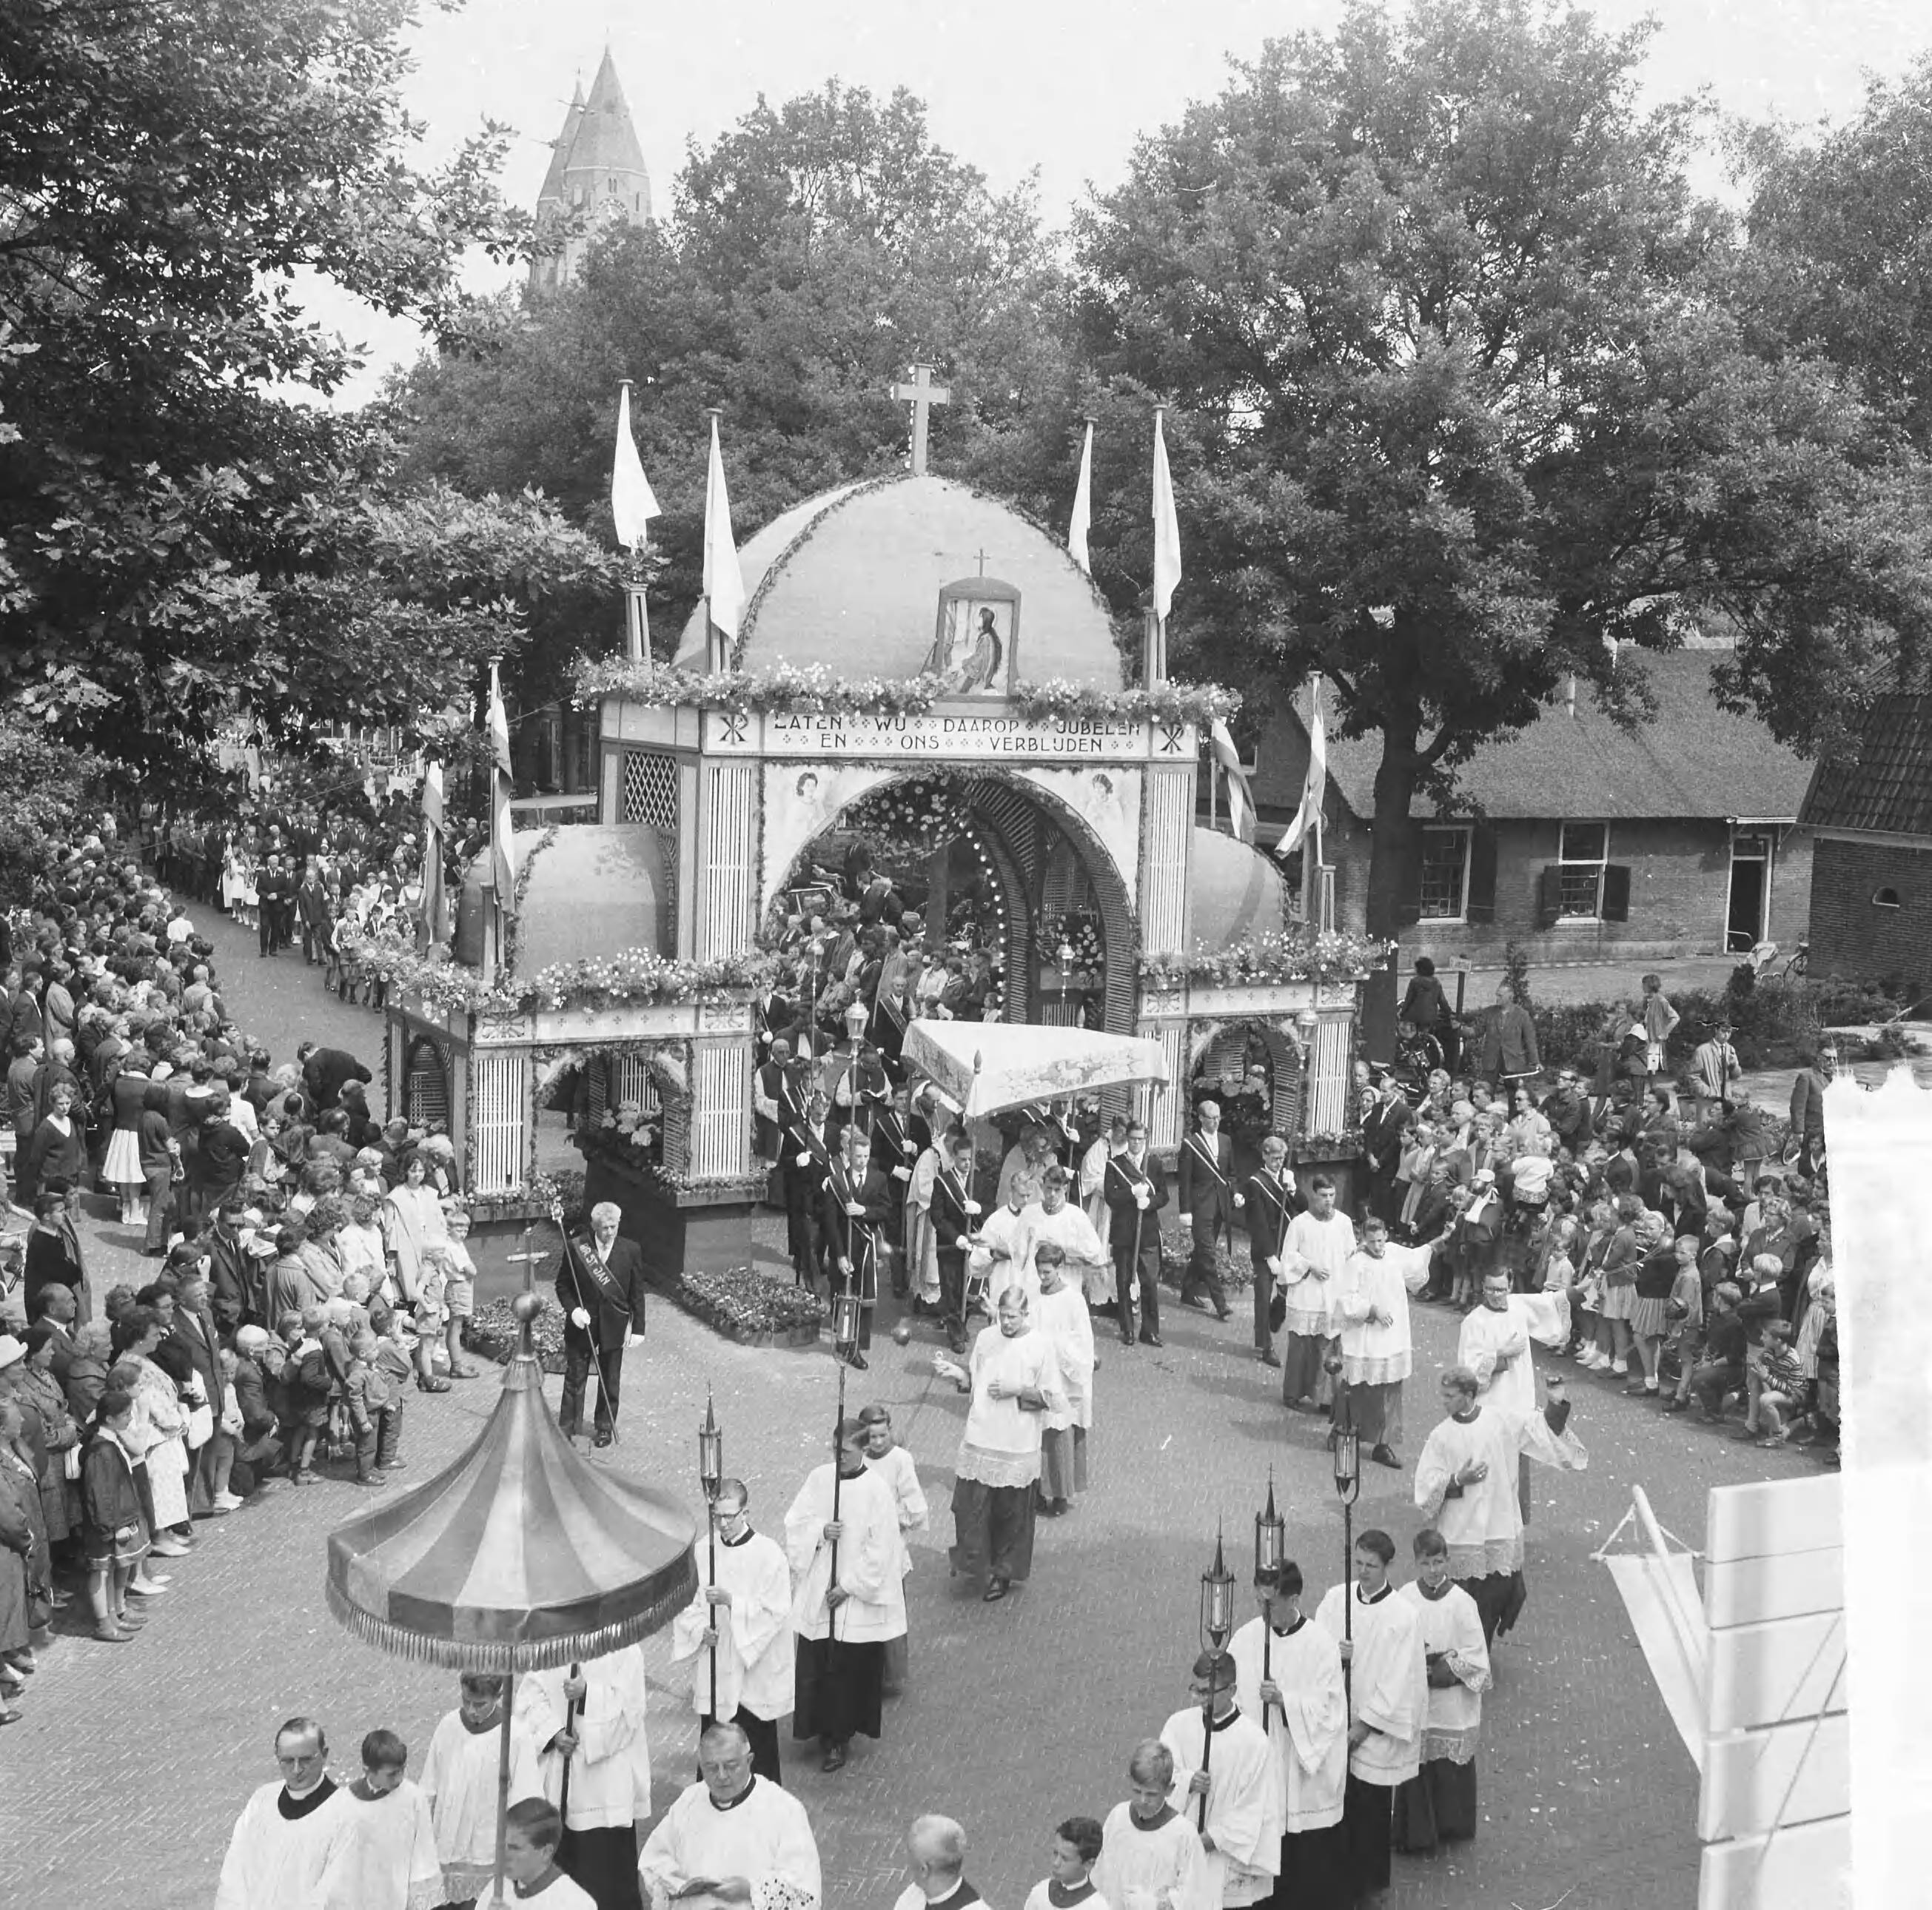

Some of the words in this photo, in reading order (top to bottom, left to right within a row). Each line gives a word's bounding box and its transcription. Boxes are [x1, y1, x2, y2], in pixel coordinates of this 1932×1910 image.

[774, 714, 842, 731] LATEN
[943, 718, 1019, 734] DAAROP
[1056, 720, 1140, 735] JUBELEN
[820, 733, 846, 748] EN
[901, 735, 939, 750] ONS
[593, 1266, 611, 1286] JAN
